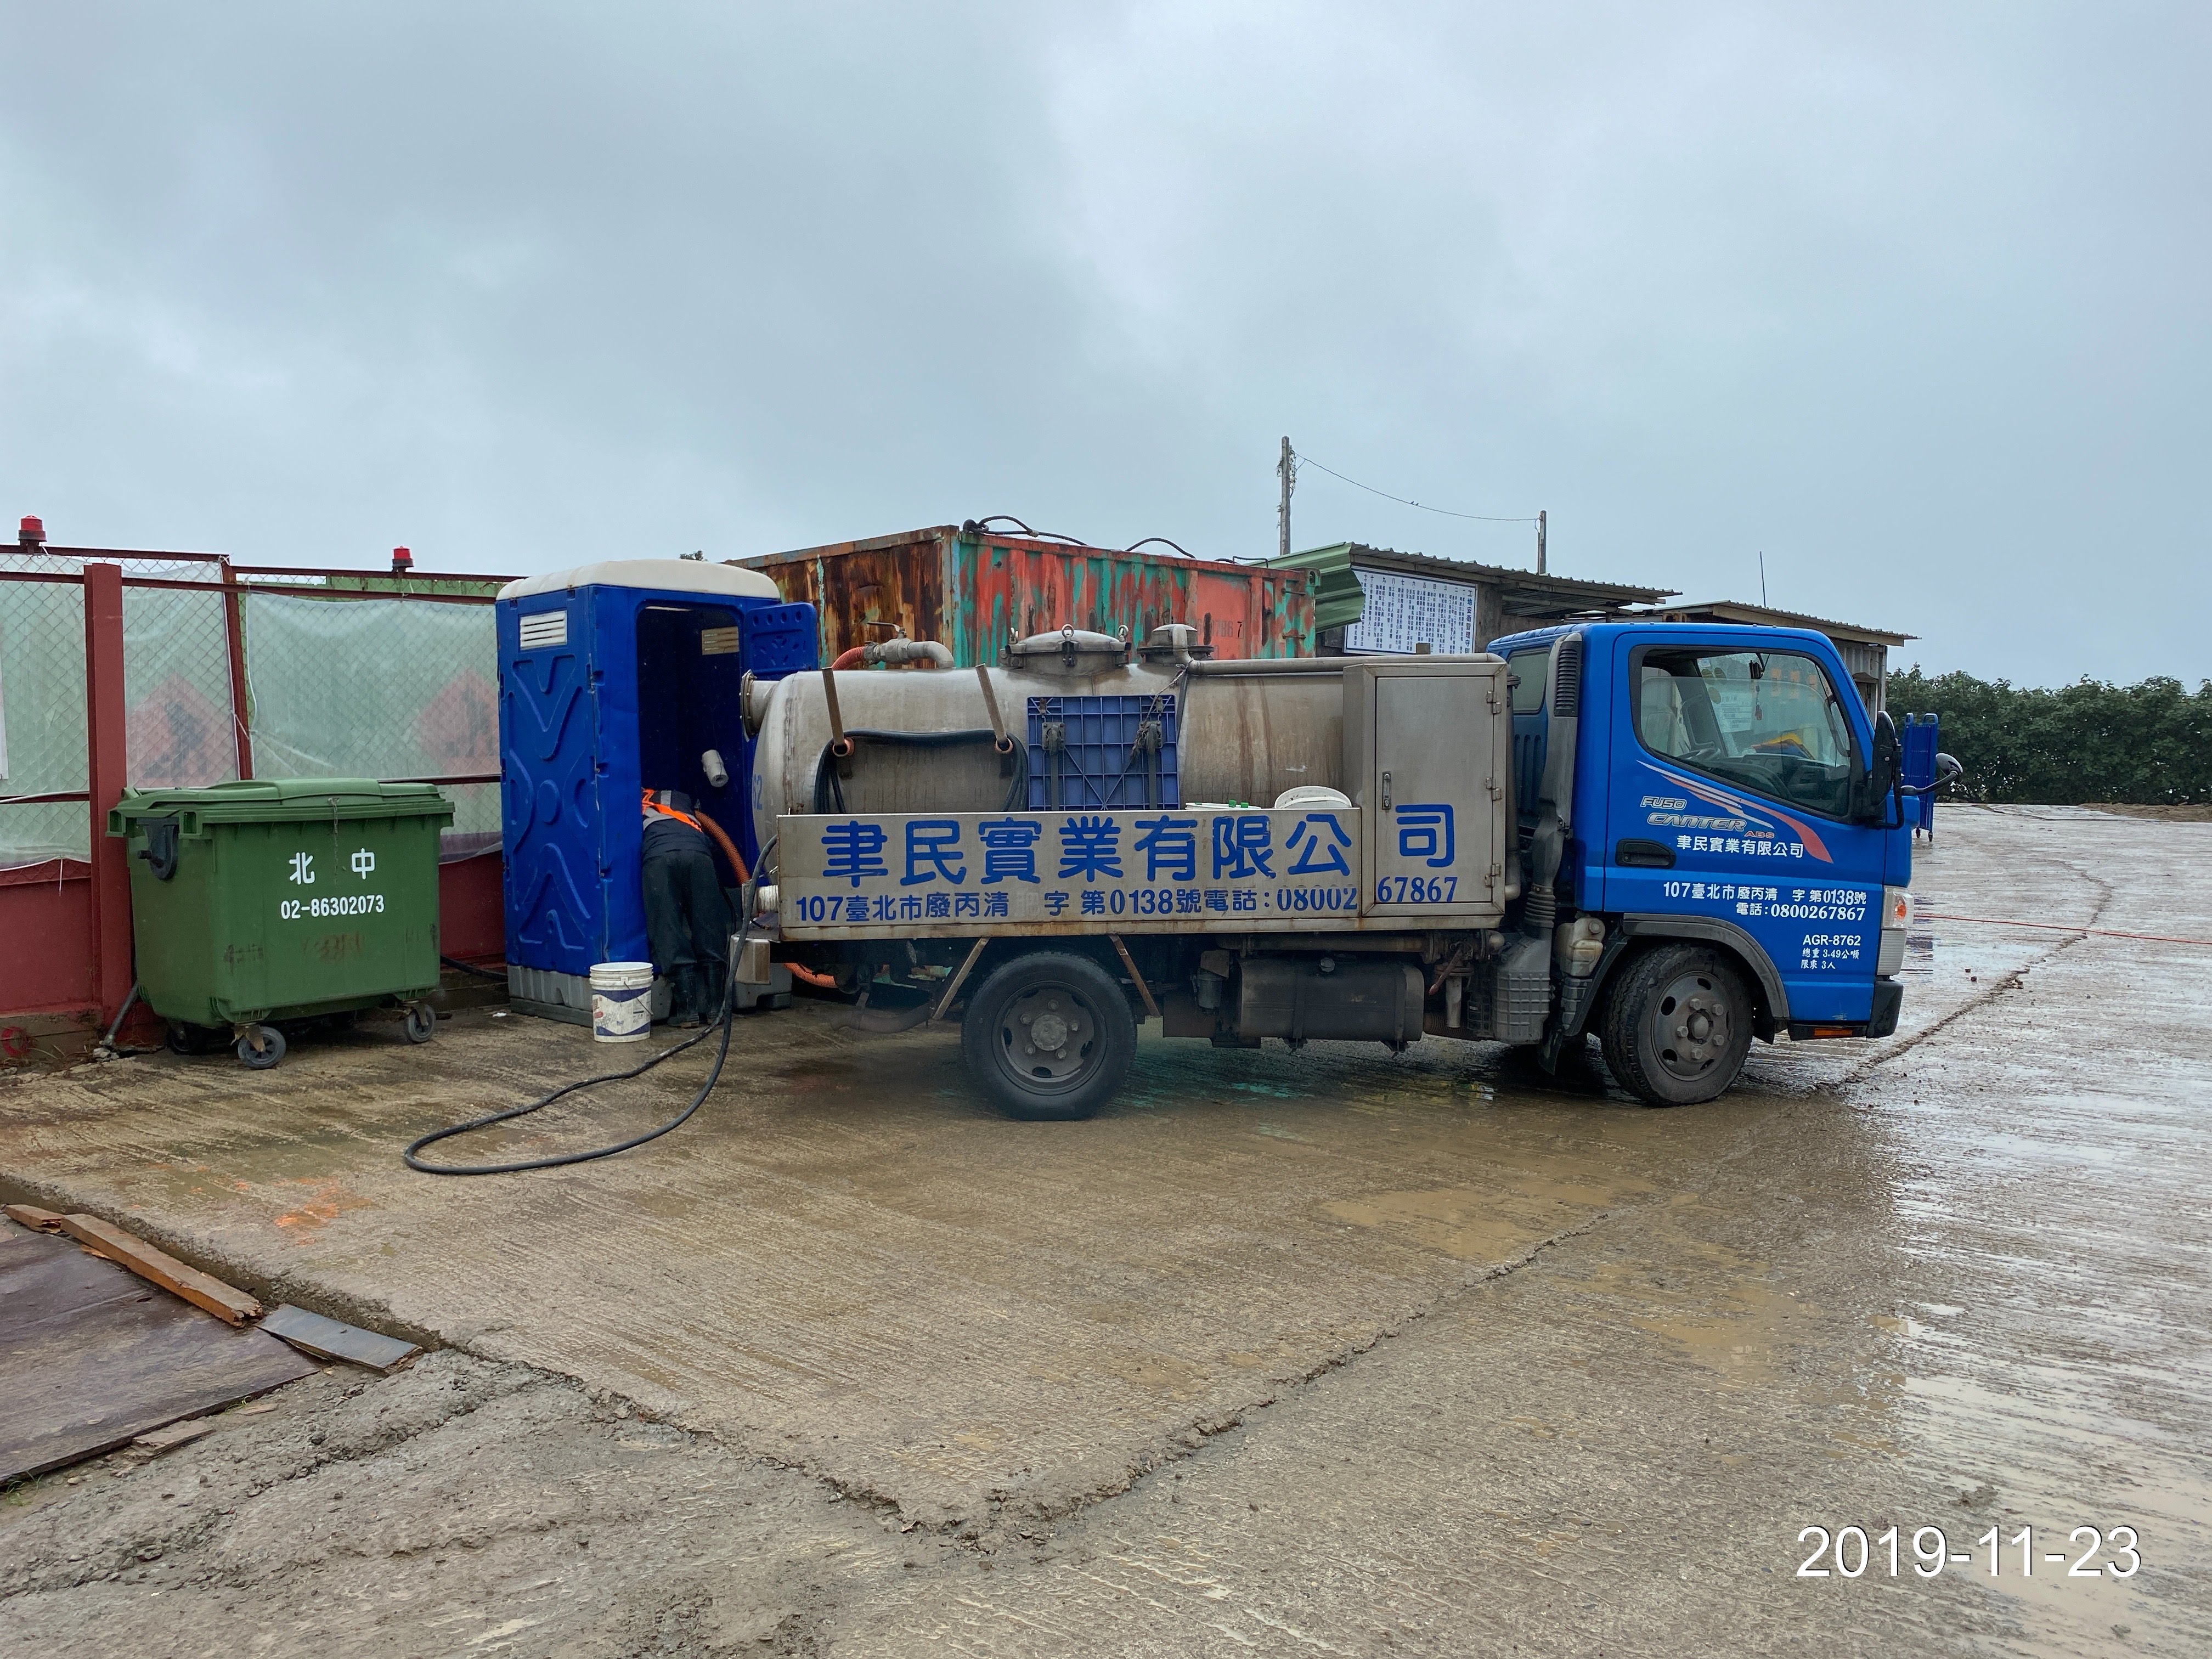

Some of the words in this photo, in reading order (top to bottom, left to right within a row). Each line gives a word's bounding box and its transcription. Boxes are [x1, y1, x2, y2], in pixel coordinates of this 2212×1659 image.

[1640, 796, 1687, 810] FUSO
[1647, 812, 1747, 832] CANTER
[1744, 831, 1774, 839] ABS
[1677, 835, 1804, 858] 聿民實業有限公司
[281, 894, 385, 919] 02-86302073
[1802, 934, 1861, 946] AGR-8762
